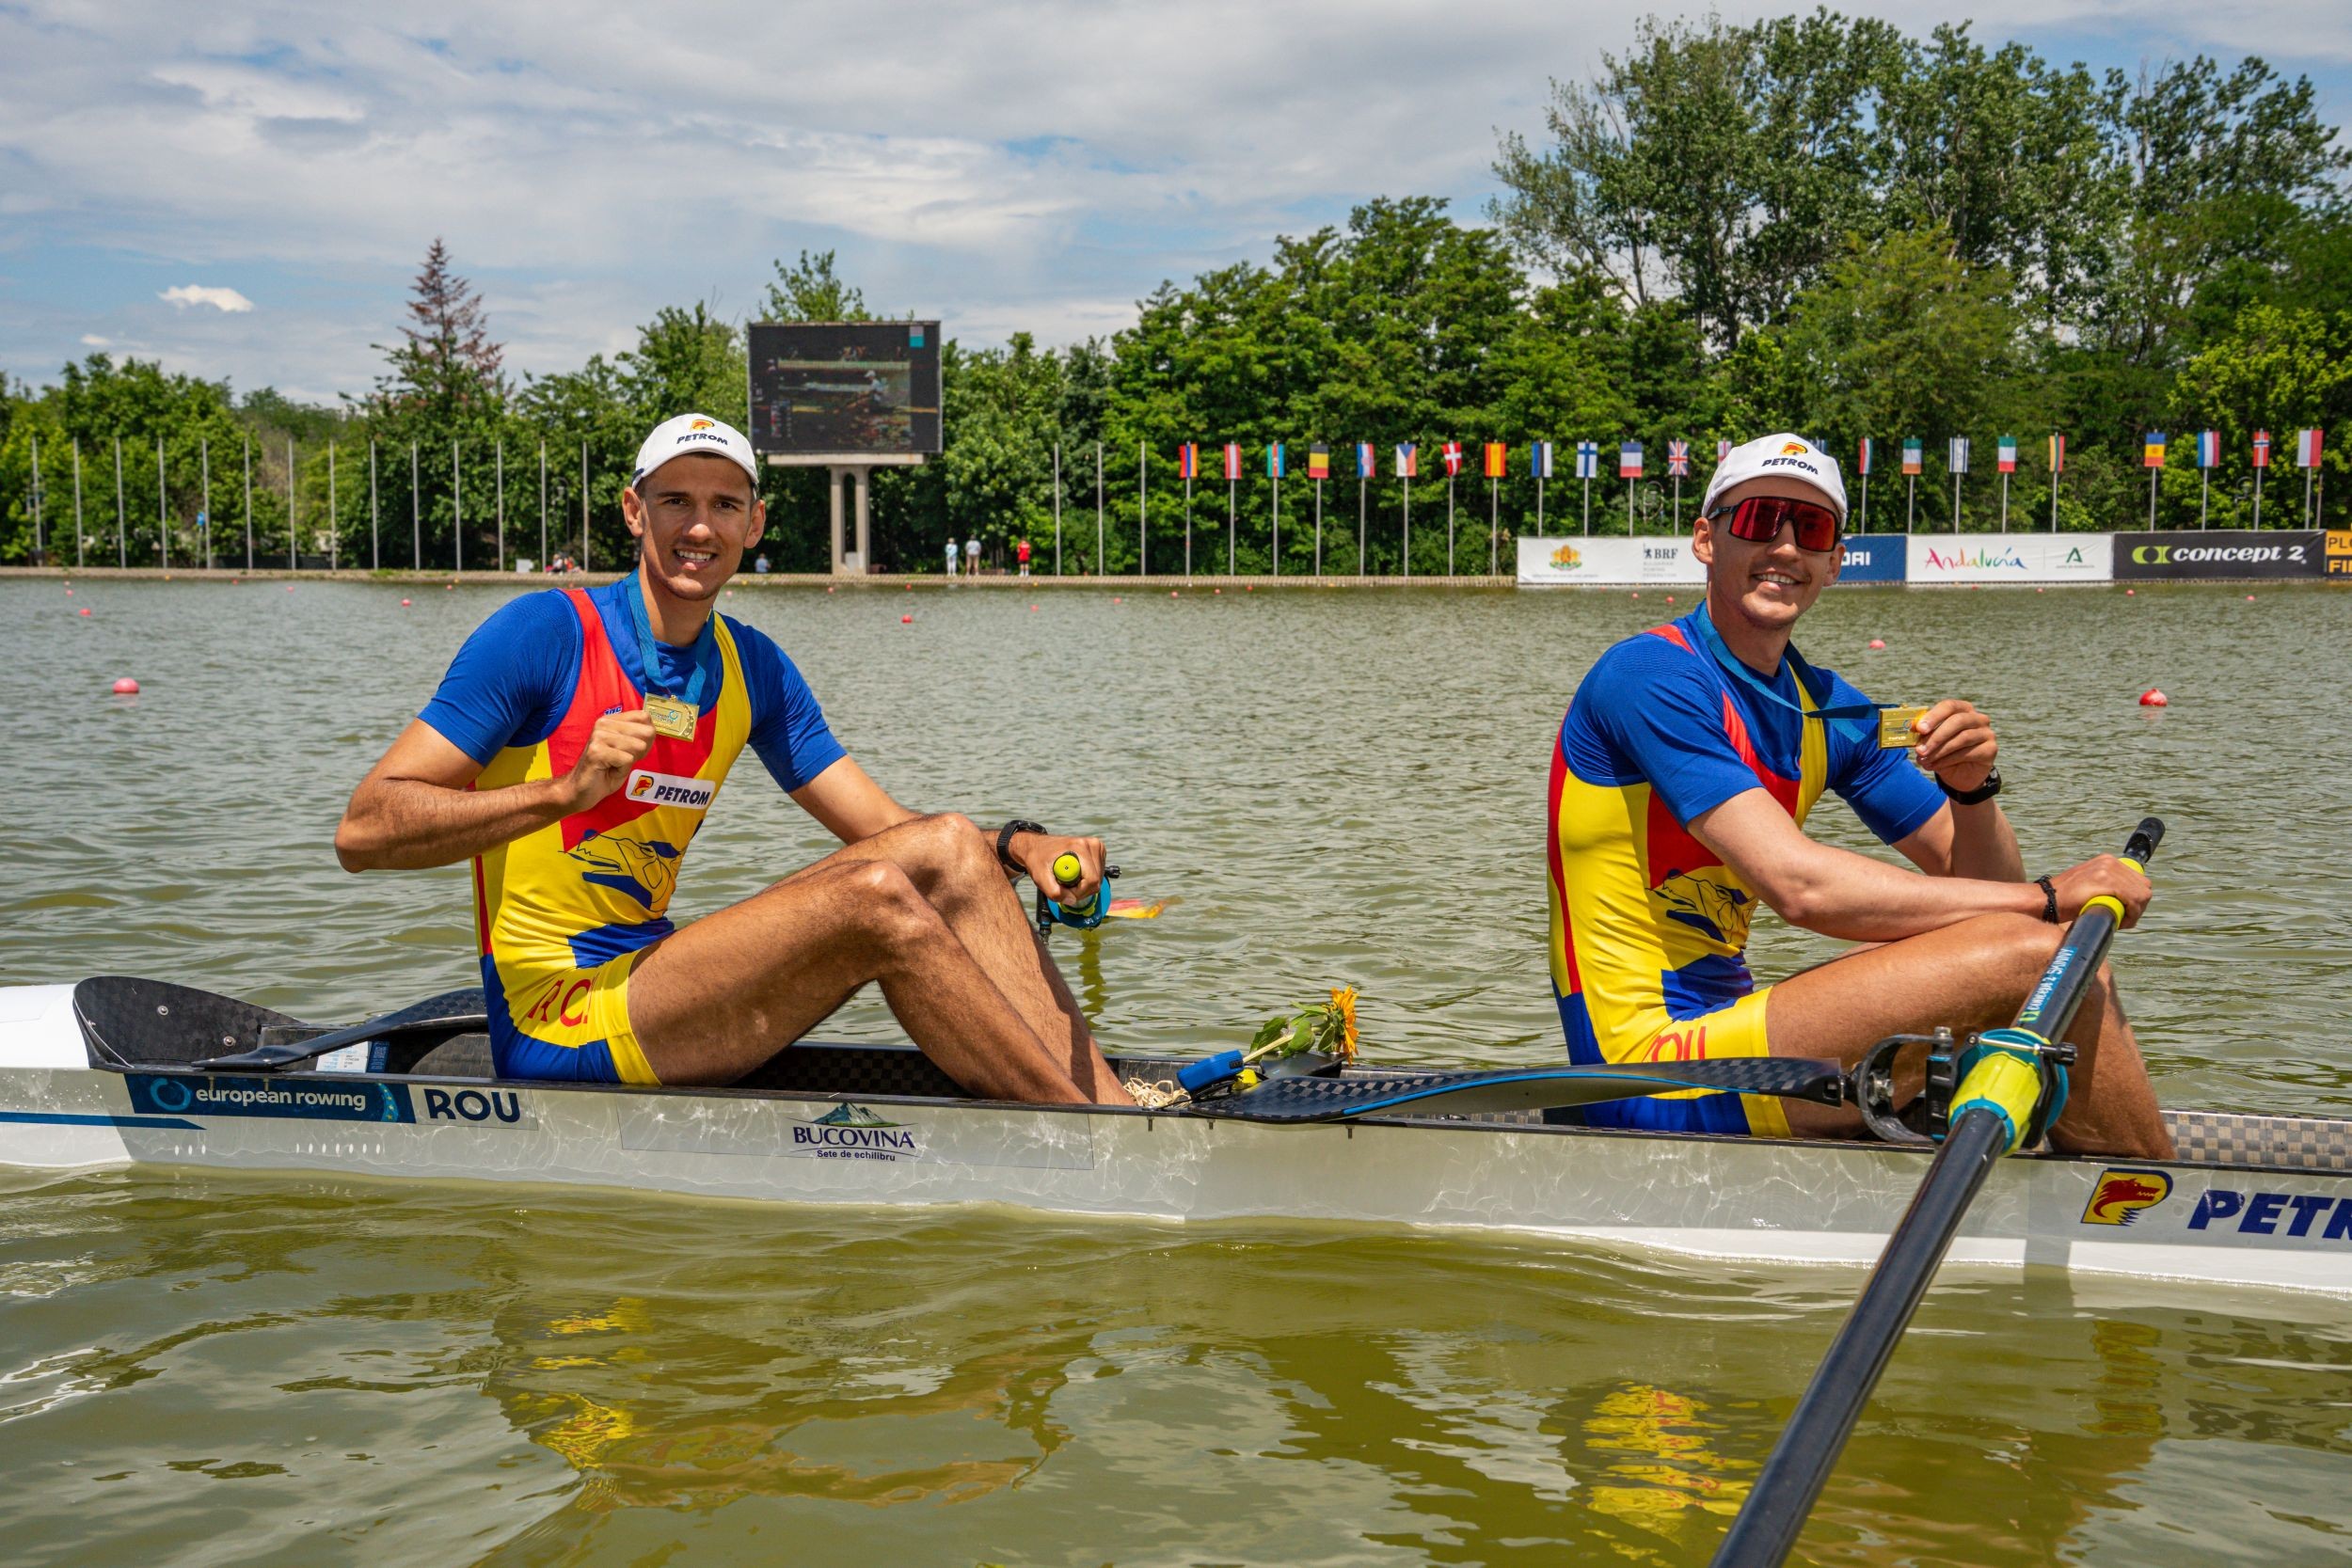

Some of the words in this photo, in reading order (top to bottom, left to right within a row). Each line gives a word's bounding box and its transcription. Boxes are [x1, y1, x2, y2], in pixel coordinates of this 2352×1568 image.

[676, 433, 728, 446] PETROM
[1761, 457, 1819, 475] PETROM
[1654, 548, 1678, 559] BRF
[1924, 546, 2028, 571] Andalucía
[2173, 546, 2283, 563] concept
[2286, 545, 2304, 562] 2
[654, 784, 711, 806] PETROM
[196, 1088, 294, 1107] european
[295, 1091, 366, 1111] rowing
[423, 1087, 521, 1123] ROU
[793, 1126, 915, 1148] BUCOVINA
[817, 1149, 838, 1158] Sete
[840, 1149, 851, 1158] de
[854, 1150, 896, 1162] echilibru
